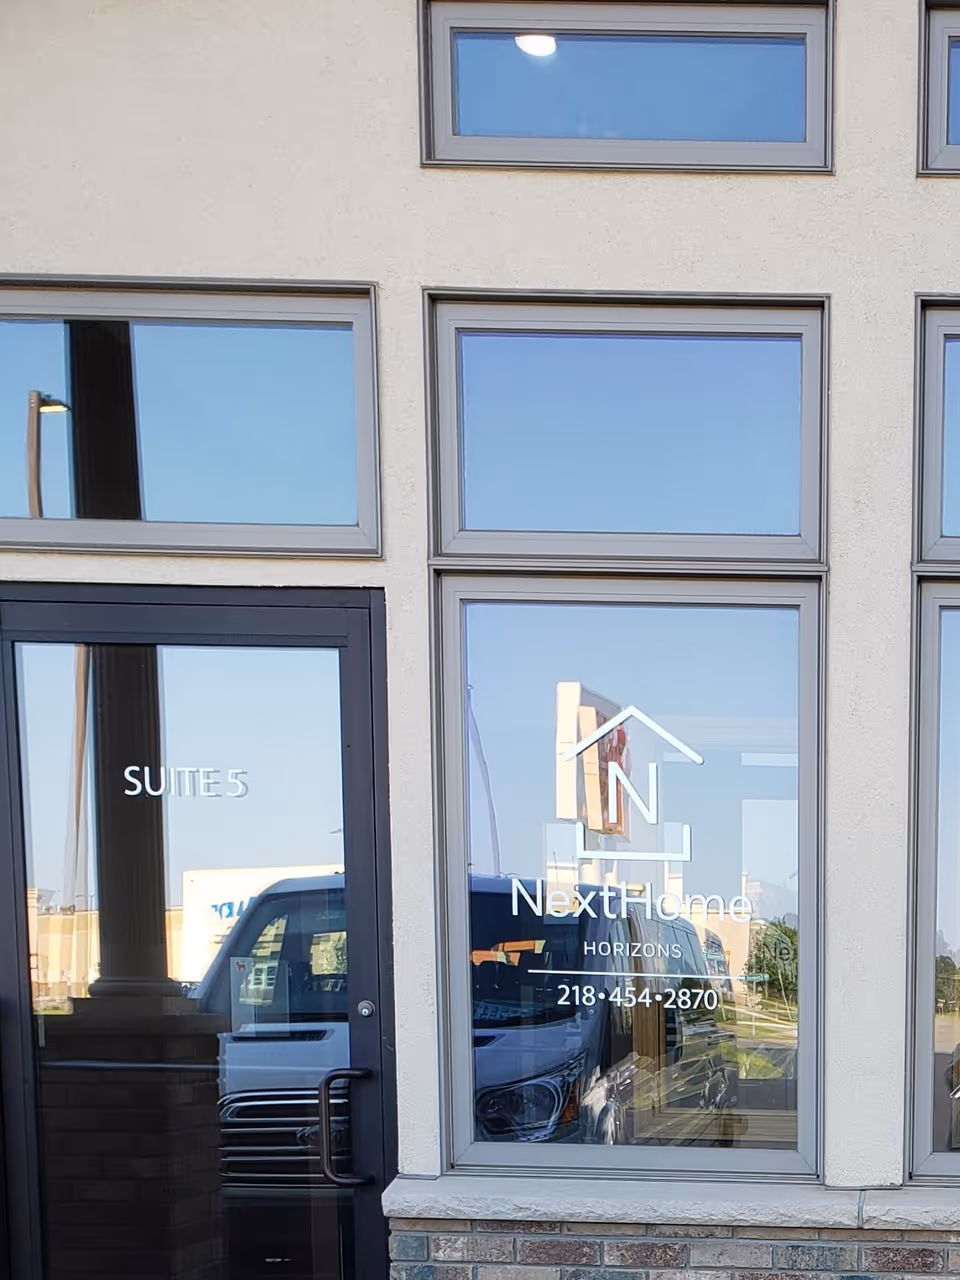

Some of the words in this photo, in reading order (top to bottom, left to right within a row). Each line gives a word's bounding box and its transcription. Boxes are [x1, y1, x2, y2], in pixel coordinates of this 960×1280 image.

[123, 765, 218, 798] SUITE
[225, 768, 248, 798] 5
[511, 877, 754, 924] NextHome
[583, 941, 683, 959] HORIZONS
